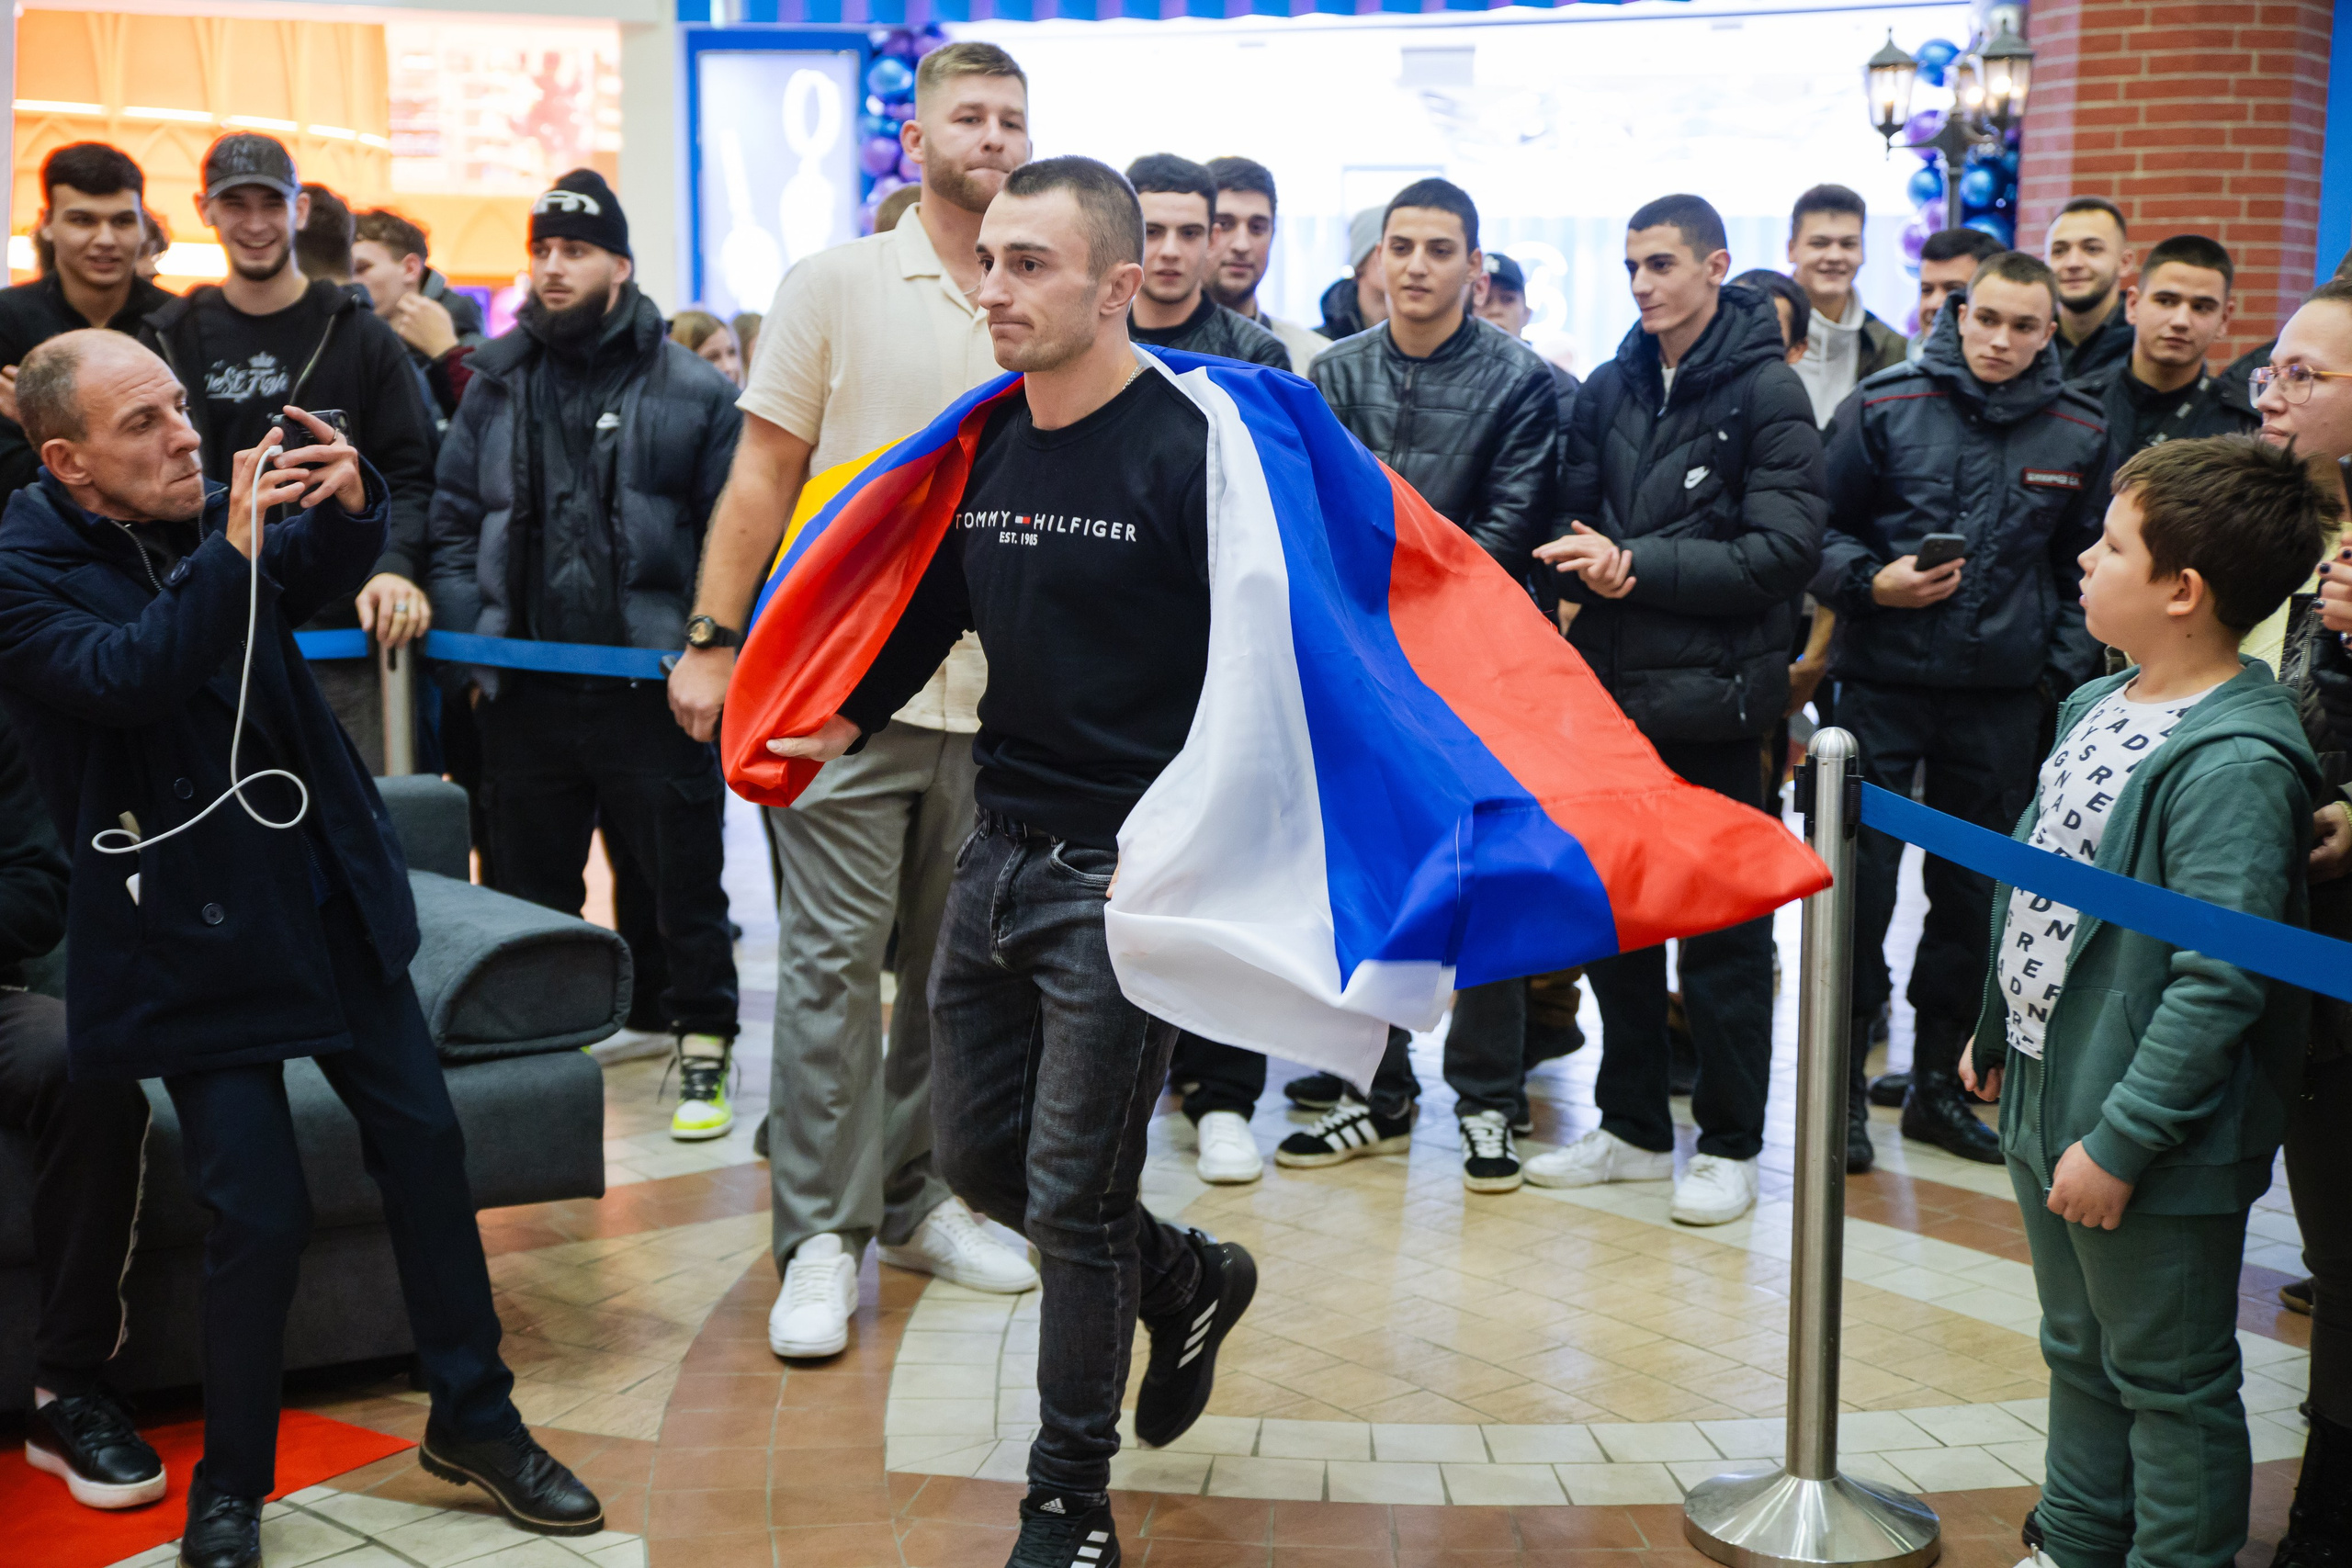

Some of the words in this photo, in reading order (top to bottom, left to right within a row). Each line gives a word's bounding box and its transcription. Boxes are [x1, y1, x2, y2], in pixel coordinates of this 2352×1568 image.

[956, 511, 1011, 530] TOMMY
[1033, 513, 1137, 542] HILFIGER
[999, 531, 1017, 544] EST.
[1021, 532, 1038, 546] 1985
[2080, 726, 2098, 741] Y
[2105, 718, 2130, 733] A
[2121, 734, 2149, 750] D
[2054, 750, 2069, 767] G
[2079, 745, 2097, 761] S
[2054, 770, 2072, 788] N
[2086, 765, 2113, 785] R
[2052, 794, 2064, 812] A
[2086, 792, 2114, 813] E
[2063, 809, 2081, 829] D
[2043, 919, 2075, 942] N
[2016, 931, 2034, 952] R
[2022, 958, 2043, 978] E
[2009, 976, 2021, 995] D
[2028, 1003, 2047, 1022] N
